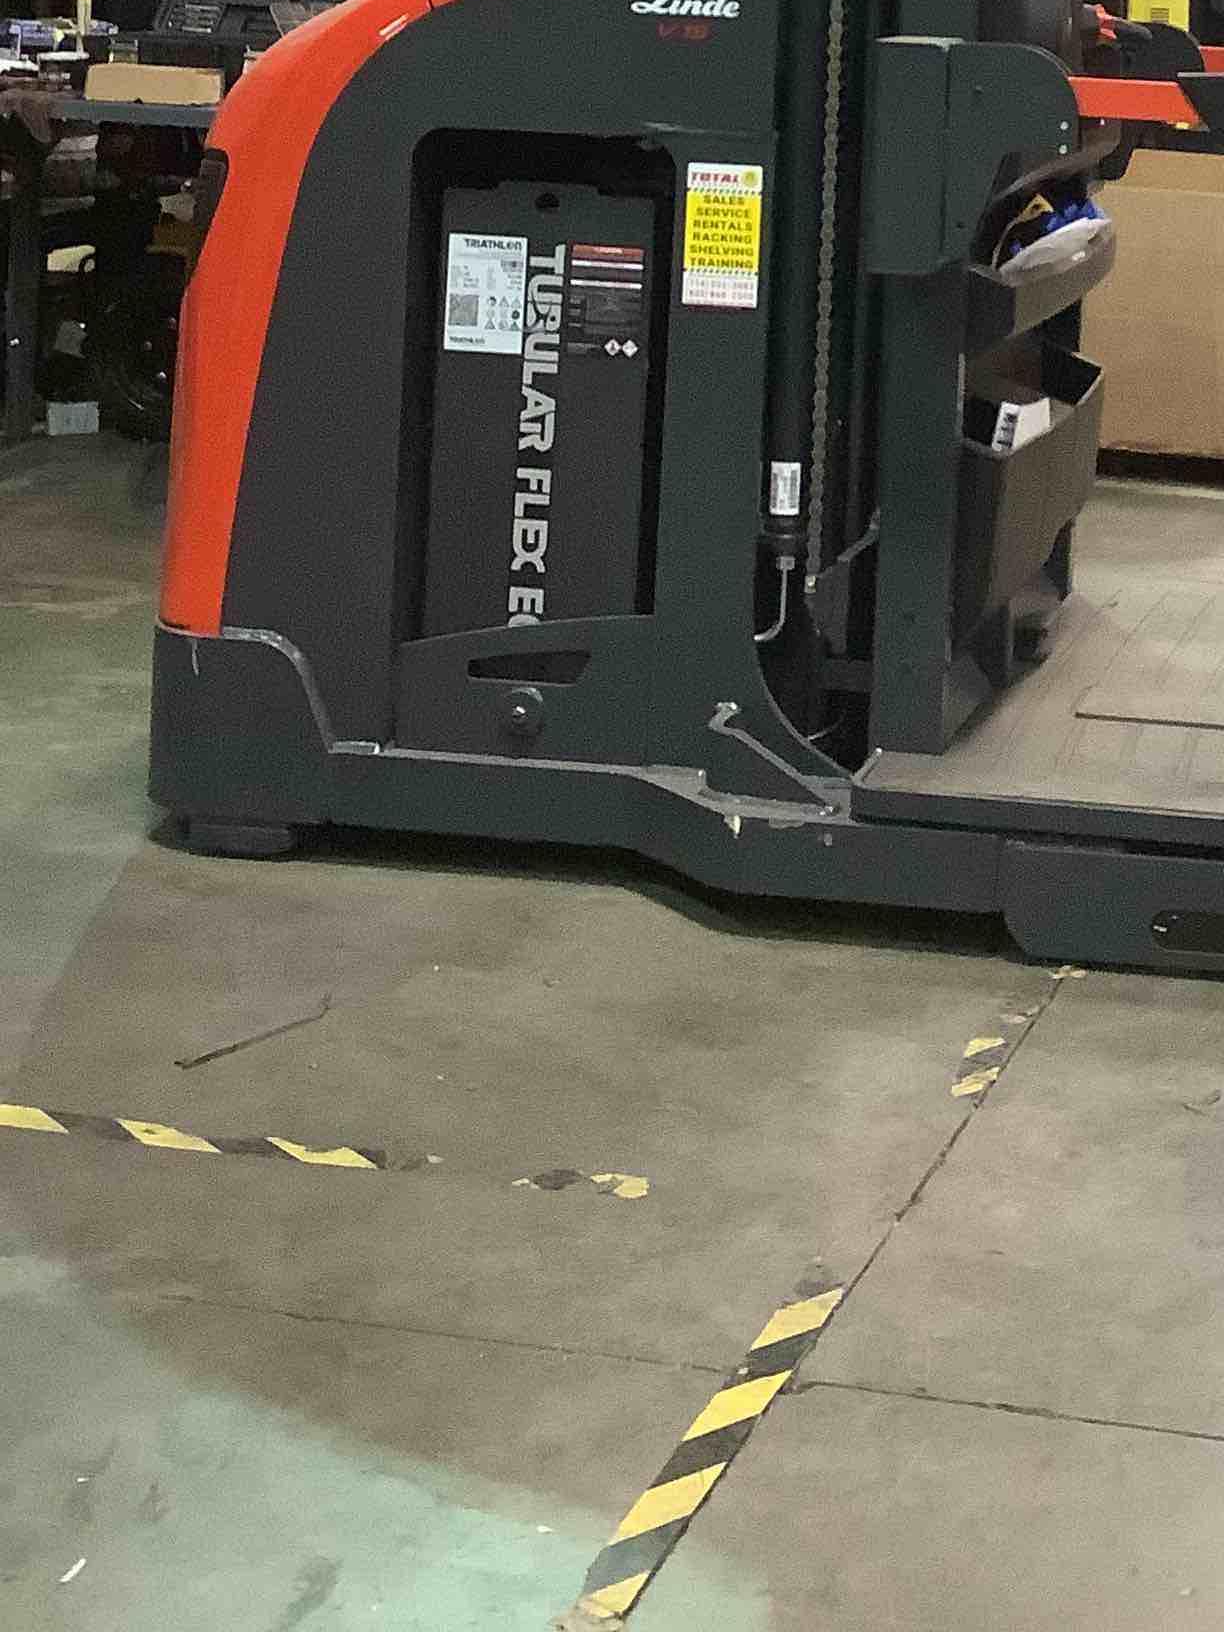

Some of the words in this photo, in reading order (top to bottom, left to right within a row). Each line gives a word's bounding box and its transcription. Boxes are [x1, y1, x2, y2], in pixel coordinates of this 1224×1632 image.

[703, 195, 746, 205] SALES
[696, 207, 751, 218] SERVICE
[693, 220, 753, 231] RENTALS
[692, 232, 752, 244] RACKING
[689, 245, 754, 256] SHELVING
[689, 258, 754, 269] TRAINING
[517, 243, 567, 453] TUBULAR
[510, 468, 552, 574] FLEX
